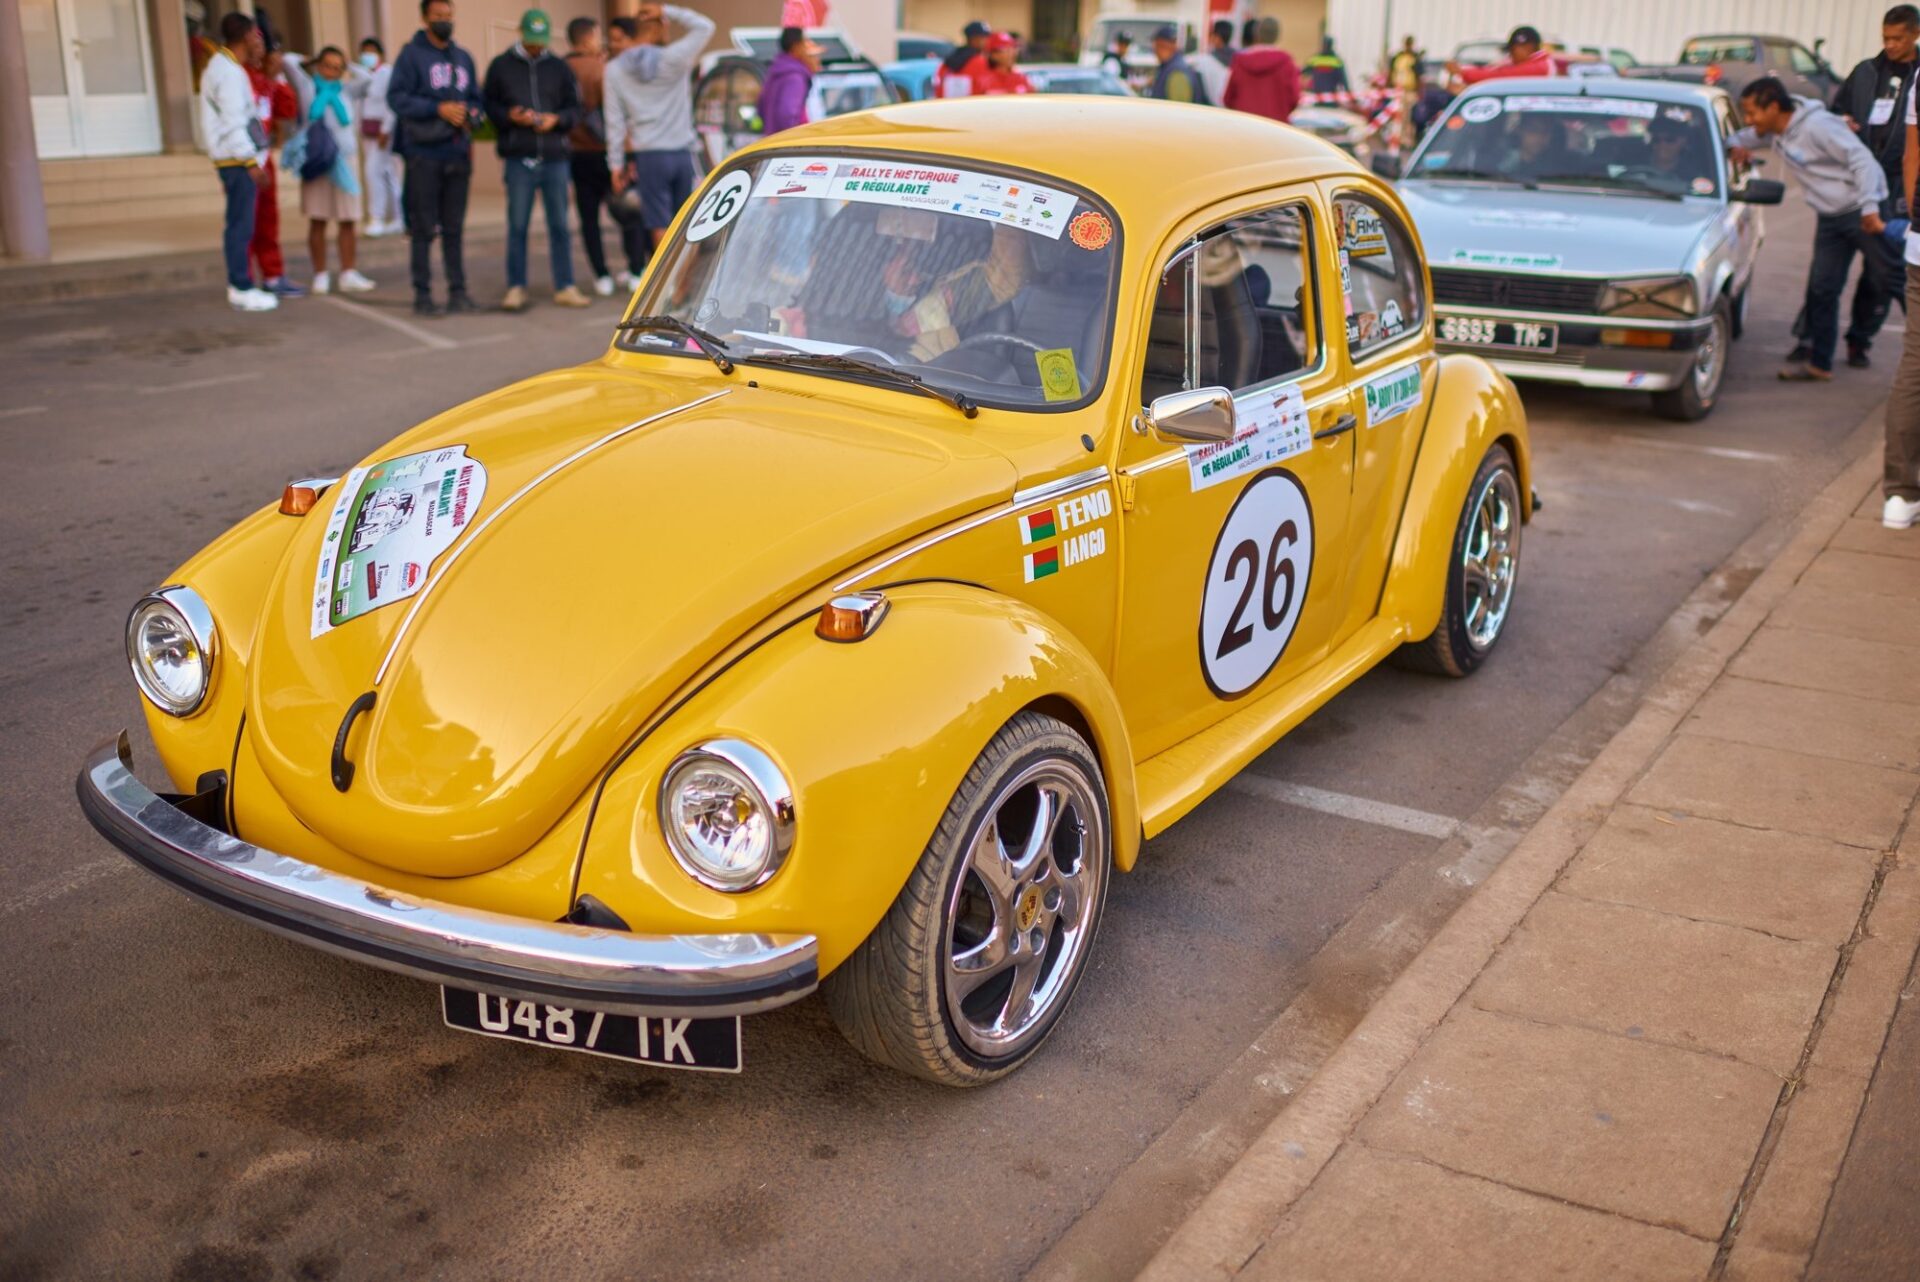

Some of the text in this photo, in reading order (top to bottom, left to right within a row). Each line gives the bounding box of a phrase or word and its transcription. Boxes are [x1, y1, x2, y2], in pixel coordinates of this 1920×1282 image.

[845, 178, 931, 195] DE RÉGULARITÉ
[850, 167, 960, 184] RALLYE HISTORIQUE
[690, 184, 742, 229] 26
[458, 464, 474, 487] RALLYE
[1202, 463, 1212, 478] DE
[425, 499, 436, 537] MADAGASCAR
[1057, 488, 1112, 532] FENO
[1063, 527, 1106, 568] IANGO
[1215, 519, 1299, 661] 26
